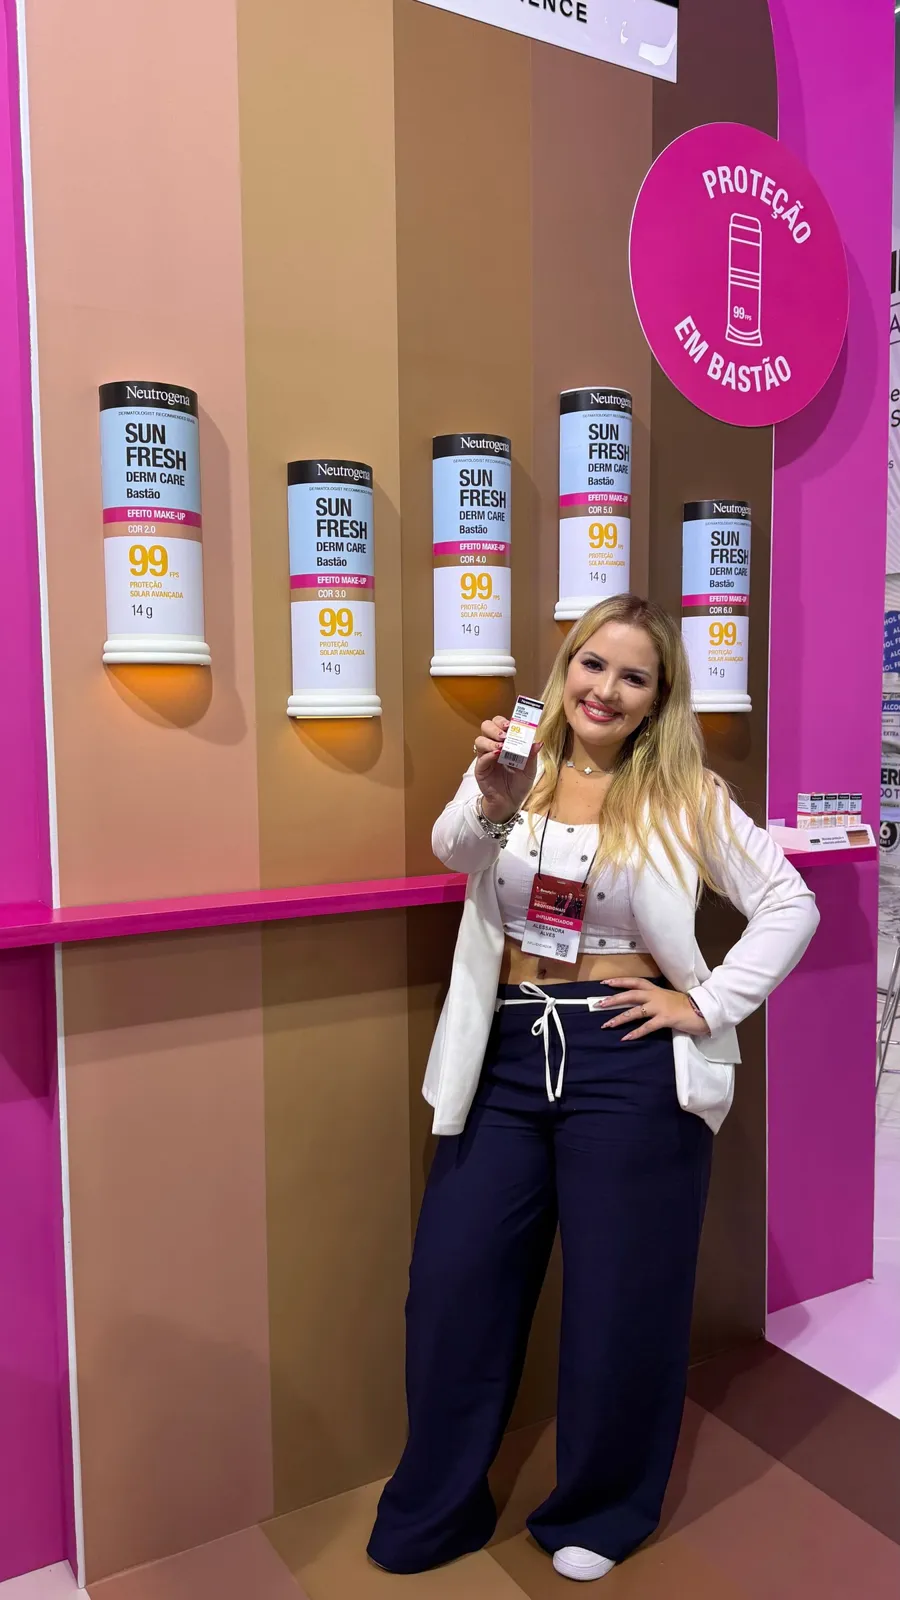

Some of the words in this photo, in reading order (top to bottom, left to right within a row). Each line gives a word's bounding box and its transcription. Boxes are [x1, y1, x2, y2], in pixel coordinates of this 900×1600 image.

[702, 165, 812, 244] PROTEÇÃO
[733, 306, 745, 319] 99
[673, 315, 709, 364] EM
[707, 351, 792, 393] BASTÃO
[126, 386, 190, 406] Neutrogena
[126, 423, 166, 444] SUN
[588, 423, 619, 440] SUN
[589, 443, 630, 462] FRESH
[126, 447, 187, 471] FRESH
[588, 463, 612, 472] DERM
[614, 463, 628, 474] CARE
[126, 472, 156, 482] DERM
[160, 473, 185, 486] CARE
[459, 469, 492, 487] SUN
[588, 476, 614, 485] Bastão
[126, 488, 160, 499] Bastão
[460, 489, 506, 508] FRESH
[316, 498, 352, 517] SUN
[588, 506, 602, 514] COR
[603, 506, 613, 514] 5.0
[128, 510, 152, 518] EFEITO
[154, 510, 186, 520] MAKE-UP
[460, 510, 485, 520] DERM
[487, 511, 505, 522] CARE
[128, 525, 143, 533] COR
[145, 525, 156, 534] 2.0
[317, 519, 367, 540] FRESH
[460, 525, 488, 534] Bastão
[588, 522, 618, 549] 99
[710, 530, 740, 546] SUN
[316, 542, 344, 552] DERM
[346, 542, 366, 553] CARE
[128, 544, 169, 577] 99
[317, 556, 347, 567] Bastão
[710, 549, 749, 565] FRESH
[590, 572, 599, 581] 14
[601, 573, 606, 583] g
[710, 567, 733, 576] DERM
[130, 581, 162, 590] PROTEÇÃO
[317, 576, 340, 584] EFEITO
[460, 572, 493, 600] 99
[710, 579, 734, 588] Bastão
[130, 590, 150, 598] SOLAR
[152, 591, 184, 599] AVANÇADA
[318, 590, 333, 598] COR
[335, 590, 346, 598] 3.0
[132, 604, 143, 616] 14
[146, 606, 153, 619] g
[461, 603, 488, 611] PROTEÇÃO
[318, 608, 354, 637] 99
[462, 624, 472, 634] 14
[474, 625, 480, 636] g
[708, 622, 737, 646] 99
[320, 640, 348, 649] PROTEÇÃO
[321, 662, 332, 672] 14
[334, 664, 341, 675] g
[708, 667, 718, 676] 14
[720, 668, 725, 678] g
[536, 914, 574, 926] INFLUENCIADOR
[532, 923, 565, 934] ALESSANDRA
[540, 930, 556, 938] ALVES
